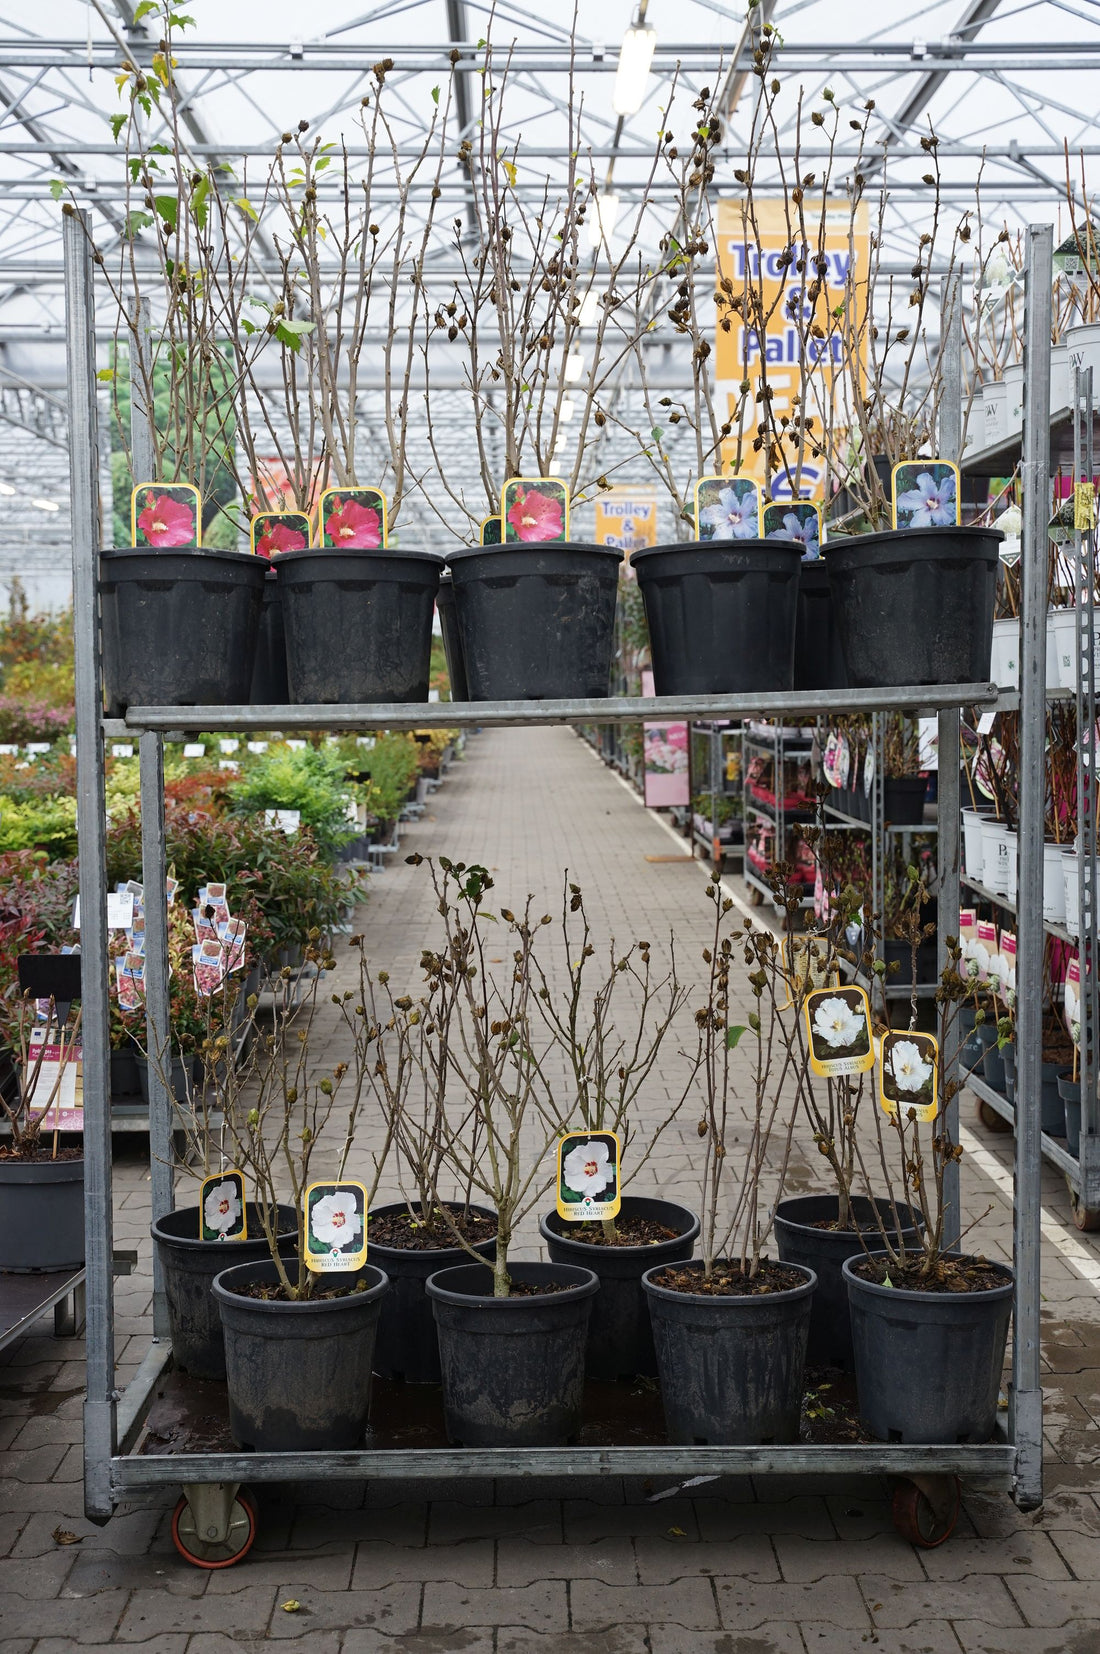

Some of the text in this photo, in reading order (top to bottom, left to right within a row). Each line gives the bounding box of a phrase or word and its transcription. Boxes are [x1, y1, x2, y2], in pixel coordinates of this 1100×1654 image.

[742, 329, 842, 363] Palet
[603, 501, 650, 518] Trolley
[623, 519, 634, 531] &
